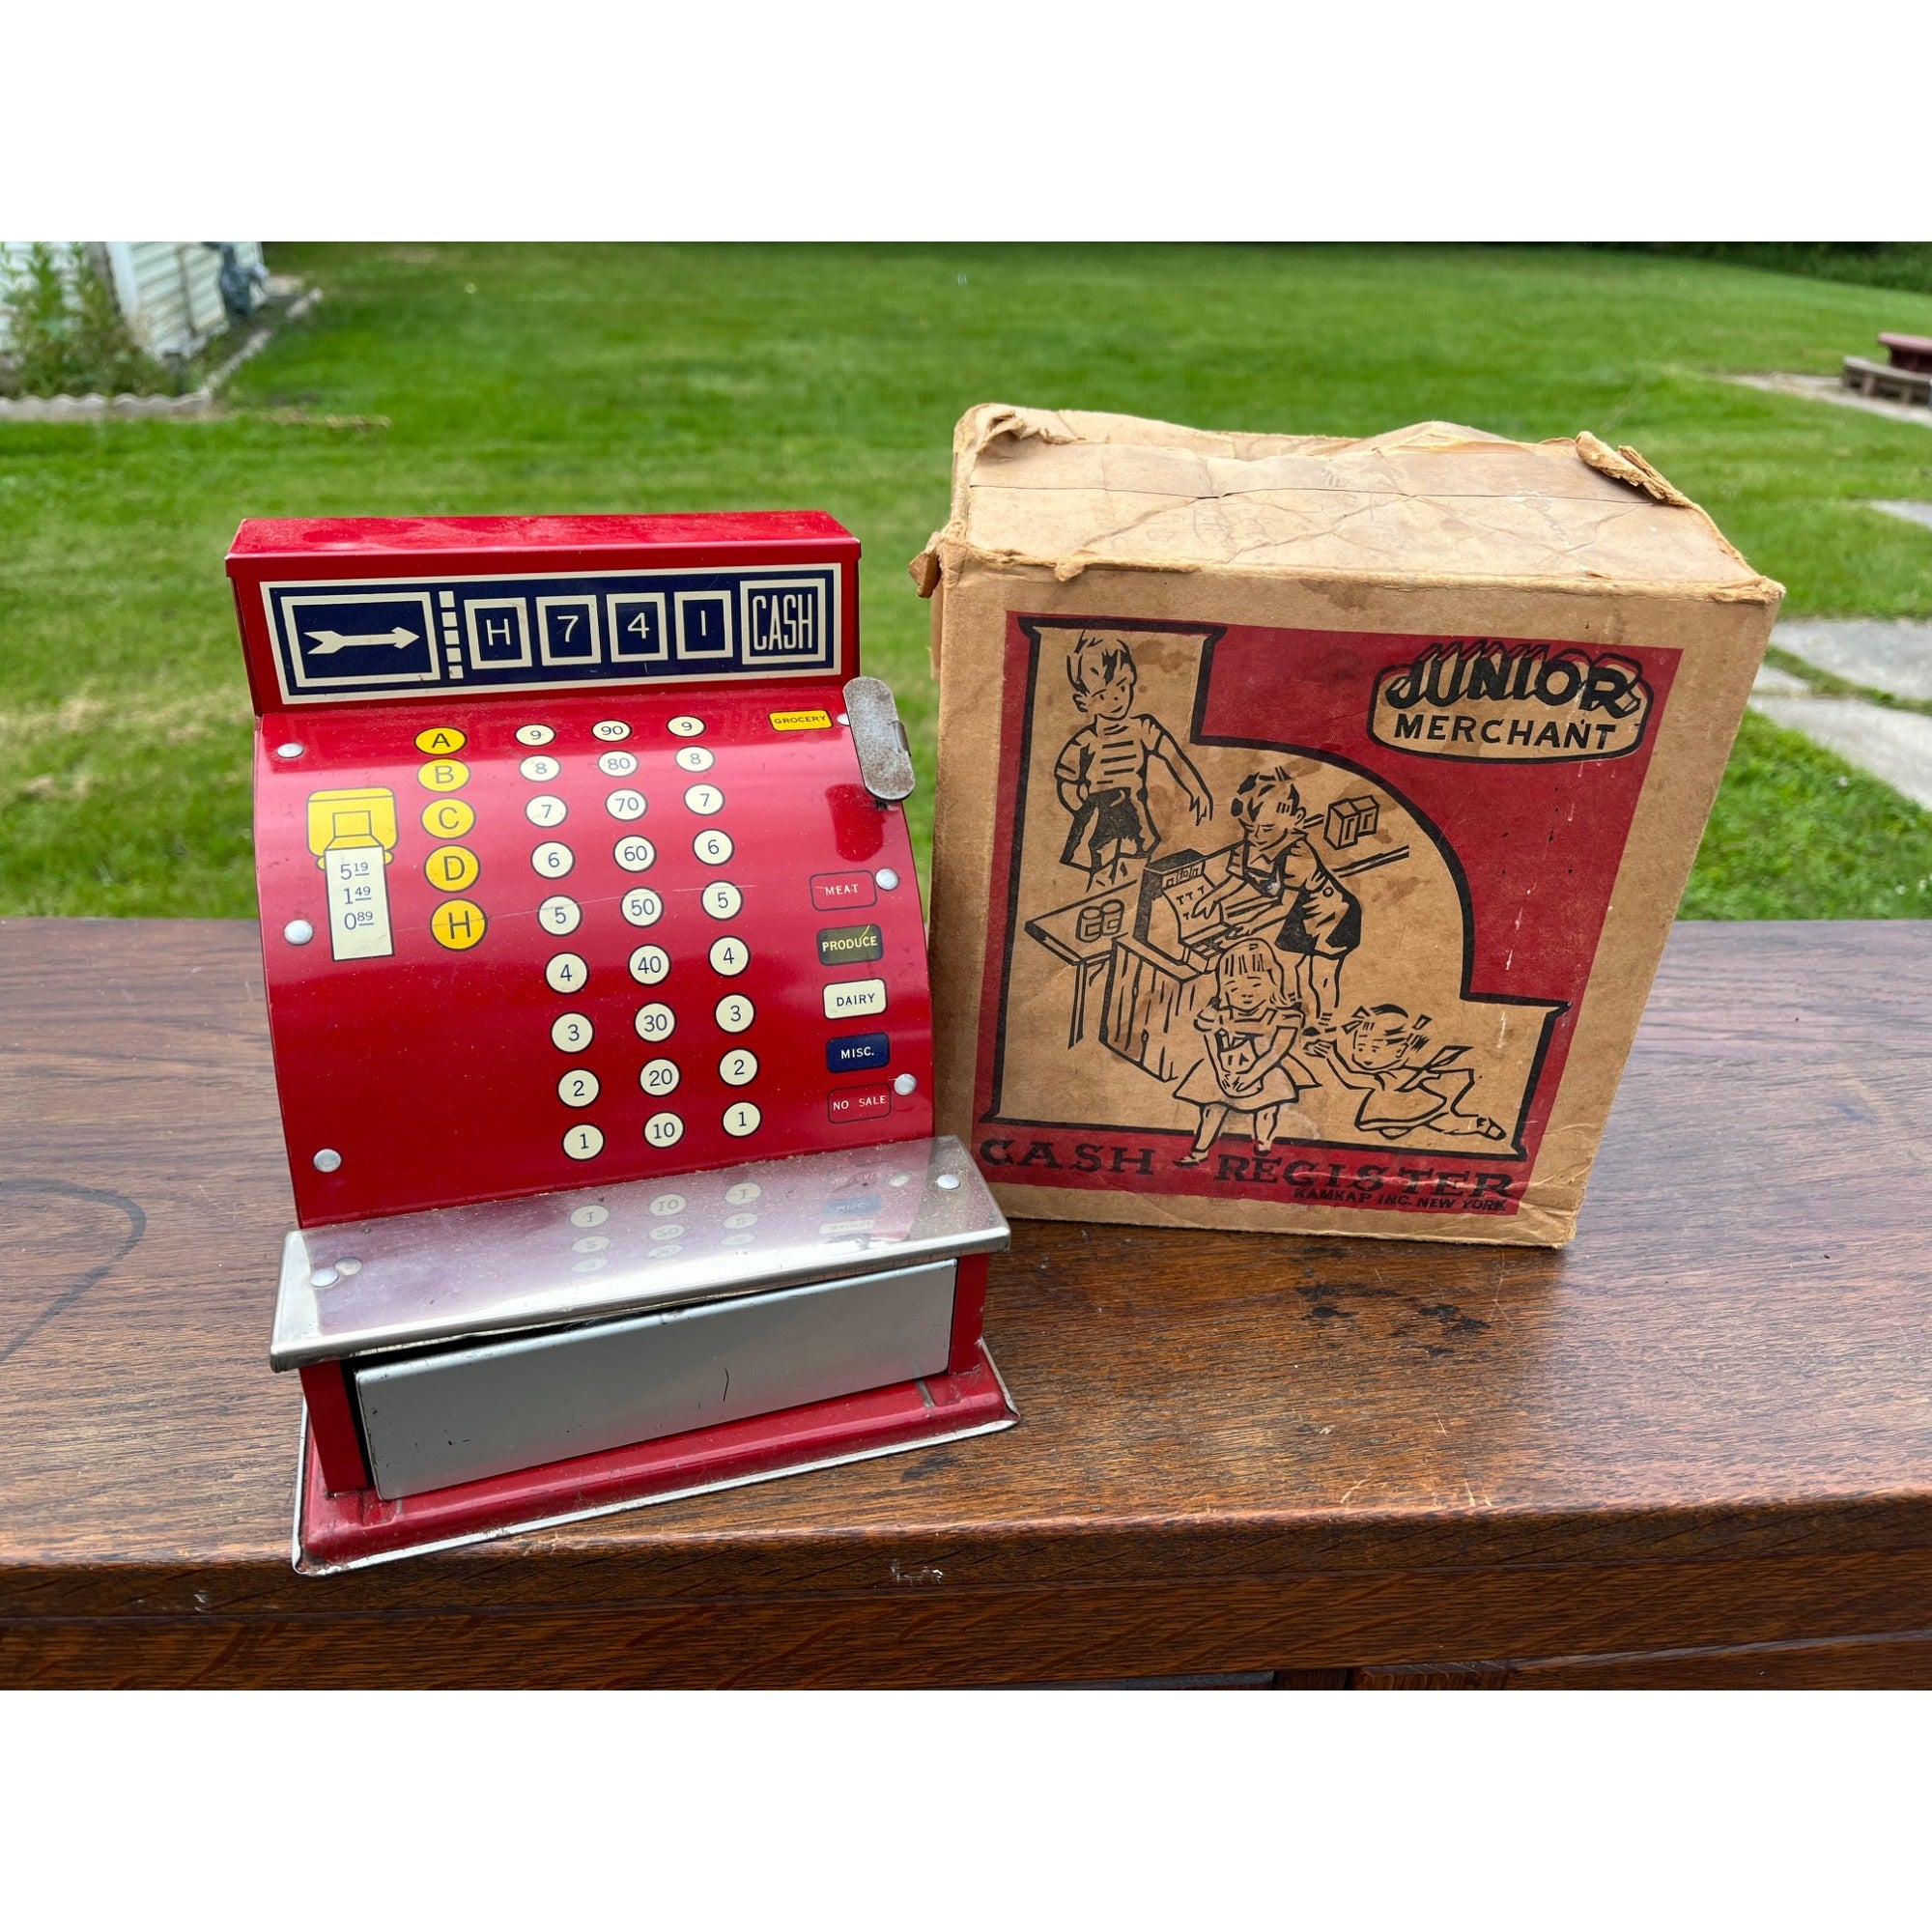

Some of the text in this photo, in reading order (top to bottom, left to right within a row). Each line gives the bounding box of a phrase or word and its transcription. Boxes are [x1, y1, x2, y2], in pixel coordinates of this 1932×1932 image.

[486, 618, 511, 646] H
[556, 614, 579, 642] 7
[627, 611, 650, 639] 4
[752, 593, 812, 651] CASH
[1385, 640, 1642, 719] JUNIOR
[680, 721, 693, 731] 9
[774, 715, 826, 724] GROCERY
[529, 729, 542, 741] 9
[600, 725, 624, 736] 90
[1394, 713, 1617, 750] MERCHANT
[431, 732, 451, 749] A
[607, 757, 631, 771] 80
[689, 753, 702, 765] 8
[434, 764, 455, 784] B
[534, 762, 548, 775] 8
[614, 797, 639, 812] 70
[699, 792, 710, 808] 7
[438, 807, 460, 830] C
[541, 804, 553, 819] 7
[623, 844, 648, 862] 60
[707, 838, 720, 855] 6
[442, 855, 466, 882] D
[548, 851, 560, 868] 6
[824, 883, 859, 896] MEAT
[631, 897, 655, 917] 50
[717, 891, 729, 909] 5
[554, 906, 567, 924] 5
[448, 910, 471, 940] H
[822, 935, 878, 952] PRODUCE
[637, 955, 662, 975] 40
[723, 947, 735, 965] 4
[559, 963, 573, 982] 4
[836, 992, 875, 1008] DAIRY
[643, 1013, 668, 1033] 30
[729, 1005, 742, 1023] 3
[567, 1023, 581, 1042] 3
[839, 1045, 875, 1060] MISC.
[733, 1059, 745, 1076] 2
[648, 1067, 673, 1087] 20
[573, 1079, 585, 1097] 2
[833, 1094, 887, 1111] NO SALE
[738, 1111, 747, 1127] 1
[653, 1122, 675, 1140] 10
[580, 1132, 589, 1150] 1
[980, 1139, 1514, 1198] CASH REGISTER
[1293, 1188, 1373, 1204] KAMKAP
[1416, 1197, 1457, 1208] NEW
[1462, 1200, 1507, 1211] YORK
